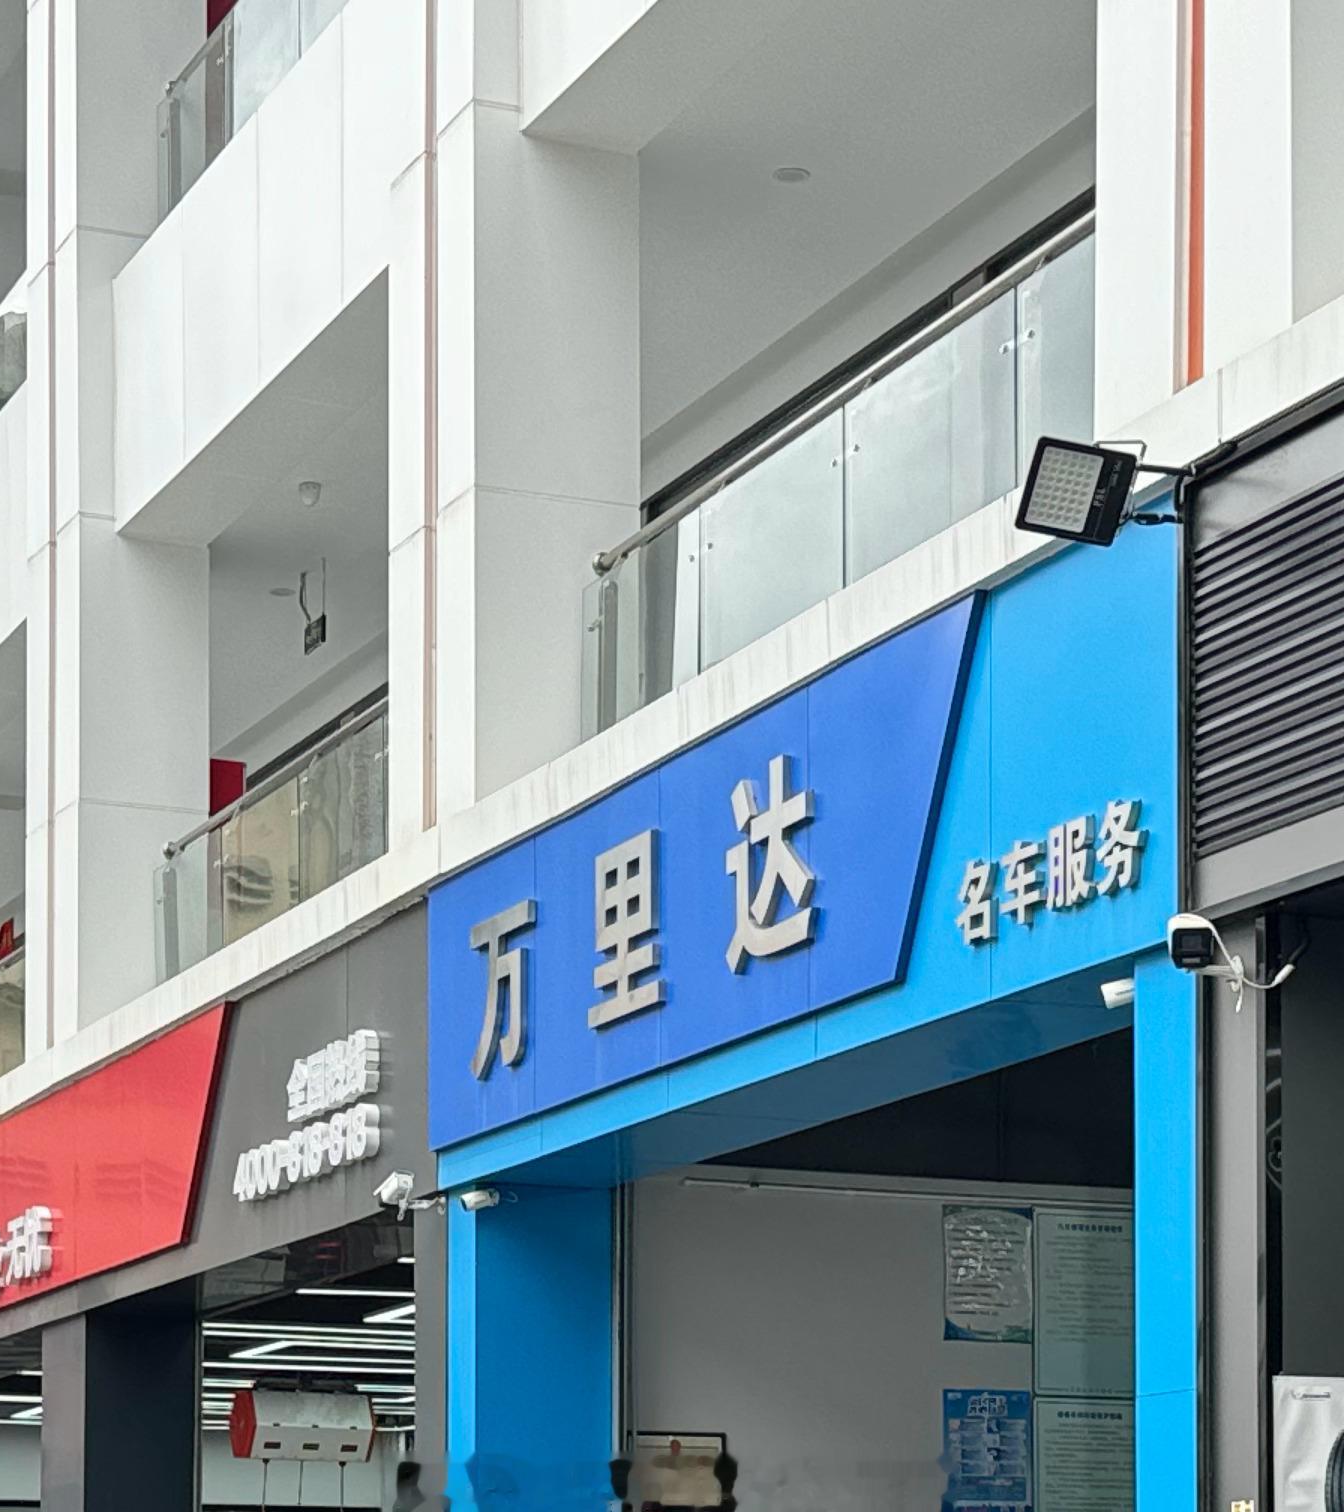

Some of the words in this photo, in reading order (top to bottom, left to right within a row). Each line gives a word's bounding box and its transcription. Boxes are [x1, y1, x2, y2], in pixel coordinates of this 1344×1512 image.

[469, 754, 820, 1081] 万里达
[956, 799, 1149, 947] 名车服务
